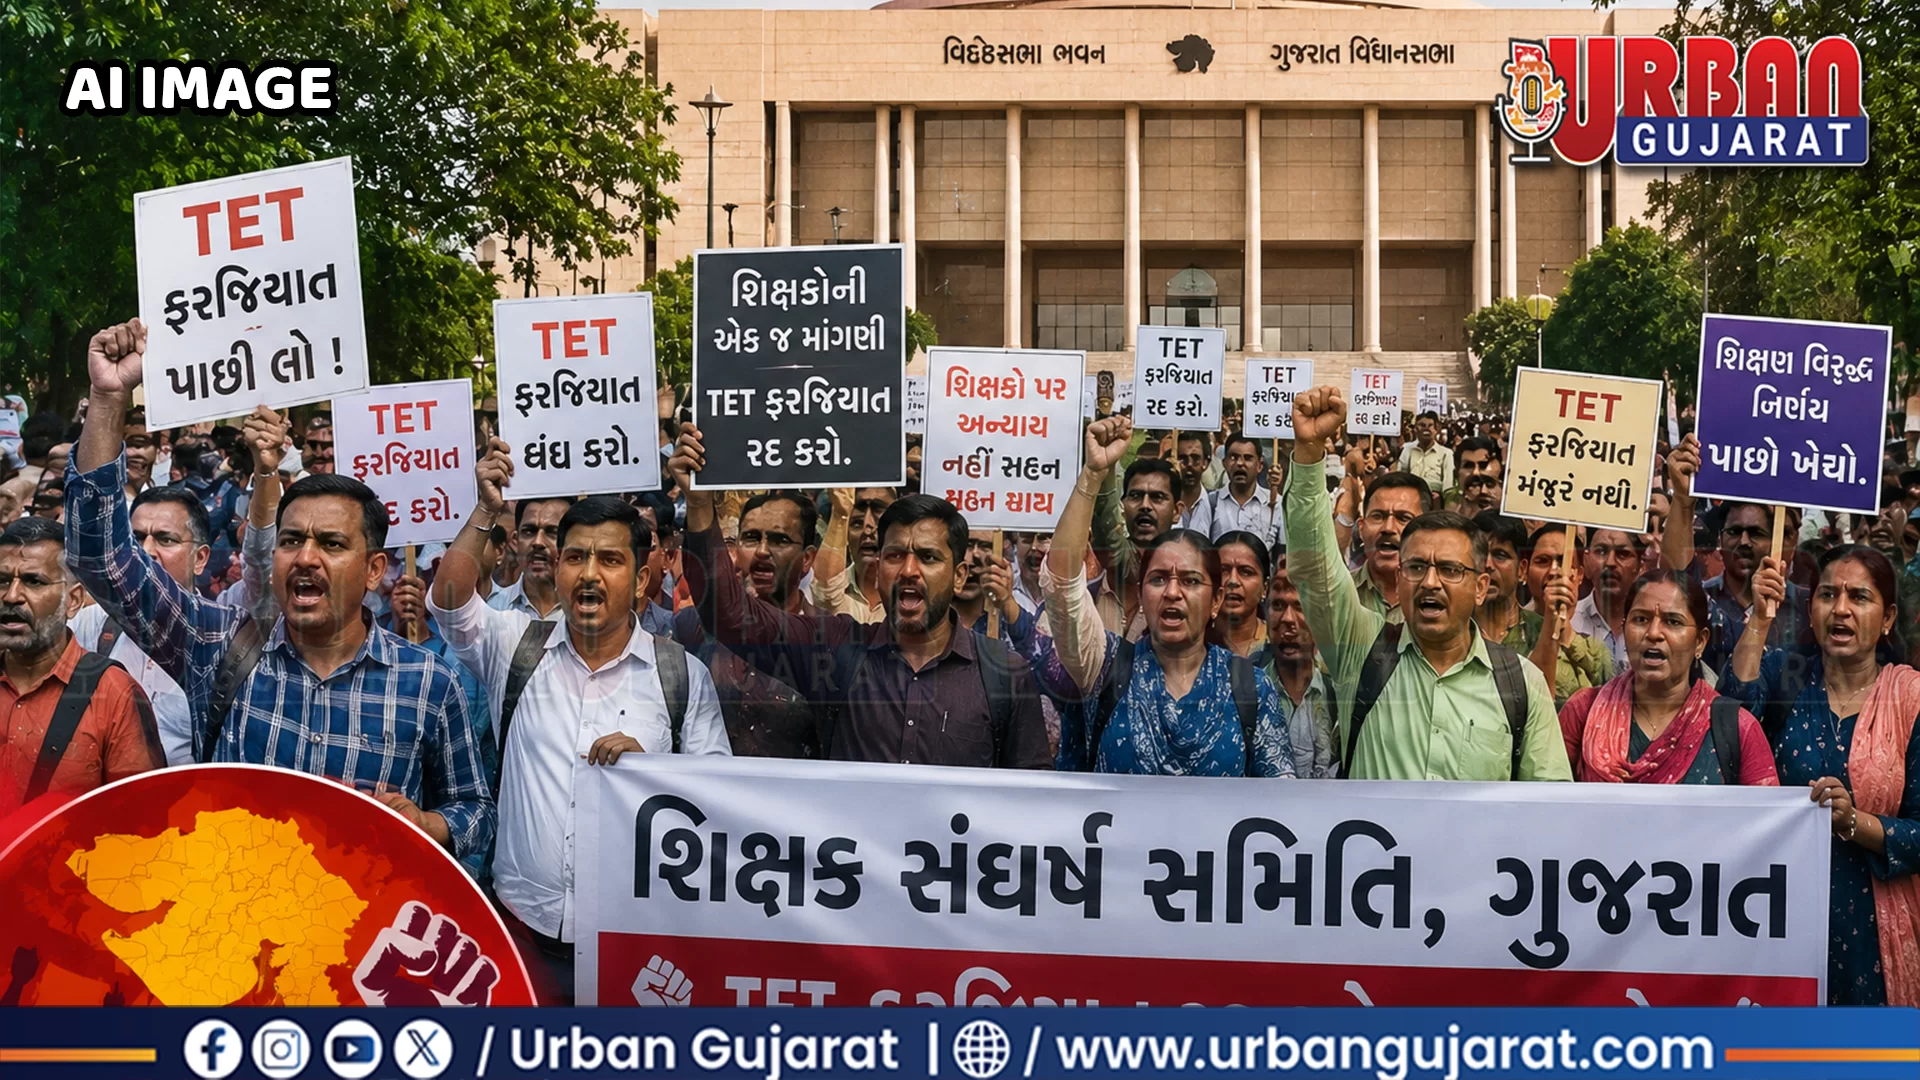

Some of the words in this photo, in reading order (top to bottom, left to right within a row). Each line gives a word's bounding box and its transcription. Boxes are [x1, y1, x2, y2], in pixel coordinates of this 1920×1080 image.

[1053, 44, 1106, 65] ભવન
[1270, 44, 1340, 72] ગુજરાત
[182, 186, 304, 257] TET
[163, 263, 338, 336] ફરજિયાત
[732, 265, 866, 311] શિક્ષકોની
[531, 317, 618, 360] TET
[713, 316, 760, 354] એક
[769, 327, 793, 353] જ
[801, 313, 885, 352] માંગણી
[1158, 336, 1204, 359] TET
[165, 339, 256, 401] પાછી
[270, 328, 315, 384] લો
[1144, 362, 1213, 387] ફરજિયાત
[1262, 366, 1297, 384] TET
[1715, 336, 1794, 377] શિક્ષણ
[514, 367, 641, 418] ફરજિયાત
[706, 388, 756, 417] TET
[765, 375, 891, 422] ફરજિયાત
[945, 365, 1025, 401] શિક્ષકો
[1034, 377, 1067, 401] પર
[1362, 374, 1391, 390] TET
[367, 400, 438, 436] TET
[956, 413, 1049, 438] અન્યાય
[1146, 398, 1168, 416] રદ
[1554, 388, 1622, 424] TET
[352, 441, 460, 483] ફરજિયાત
[583, 424, 640, 469] કરો.
[746, 438, 784, 467] રદ
[794, 425, 852, 467] કરો.
[1527, 427, 1636, 467] ફરજિયાત
[1708, 436, 1780, 478] પાછો
[410, 486, 460, 524] કરો.
[633, 793, 865, 919] શિક્ષક
[1488, 856, 1788, 971] ગુજરાત
